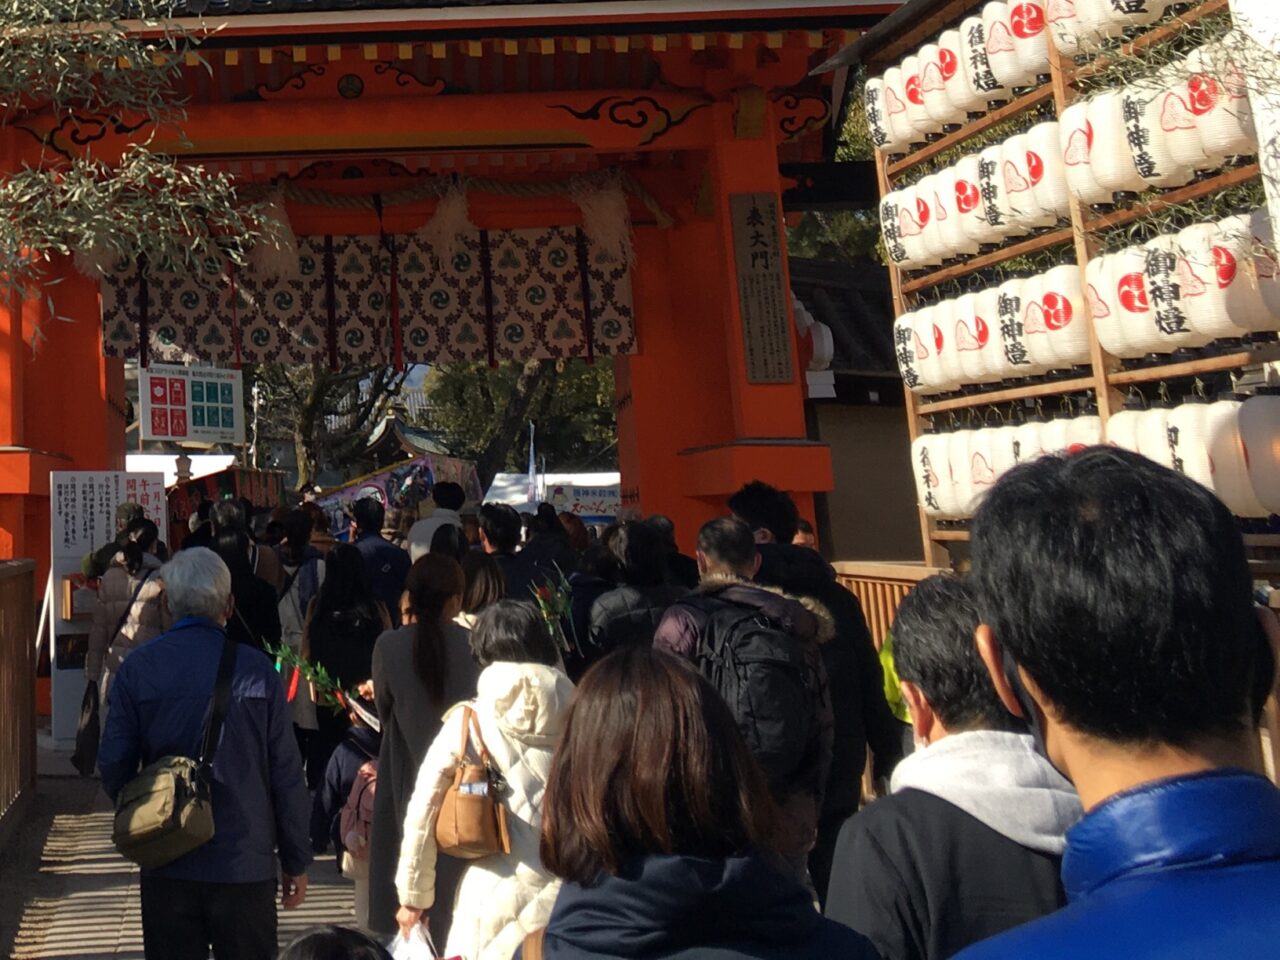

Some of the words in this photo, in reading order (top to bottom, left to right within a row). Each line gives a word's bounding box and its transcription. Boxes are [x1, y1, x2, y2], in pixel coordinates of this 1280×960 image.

[746, 206, 769, 269] 表大門
[1144, 247, 1191, 336] 御神燈
[998, 292, 1031, 365] 御神燈
